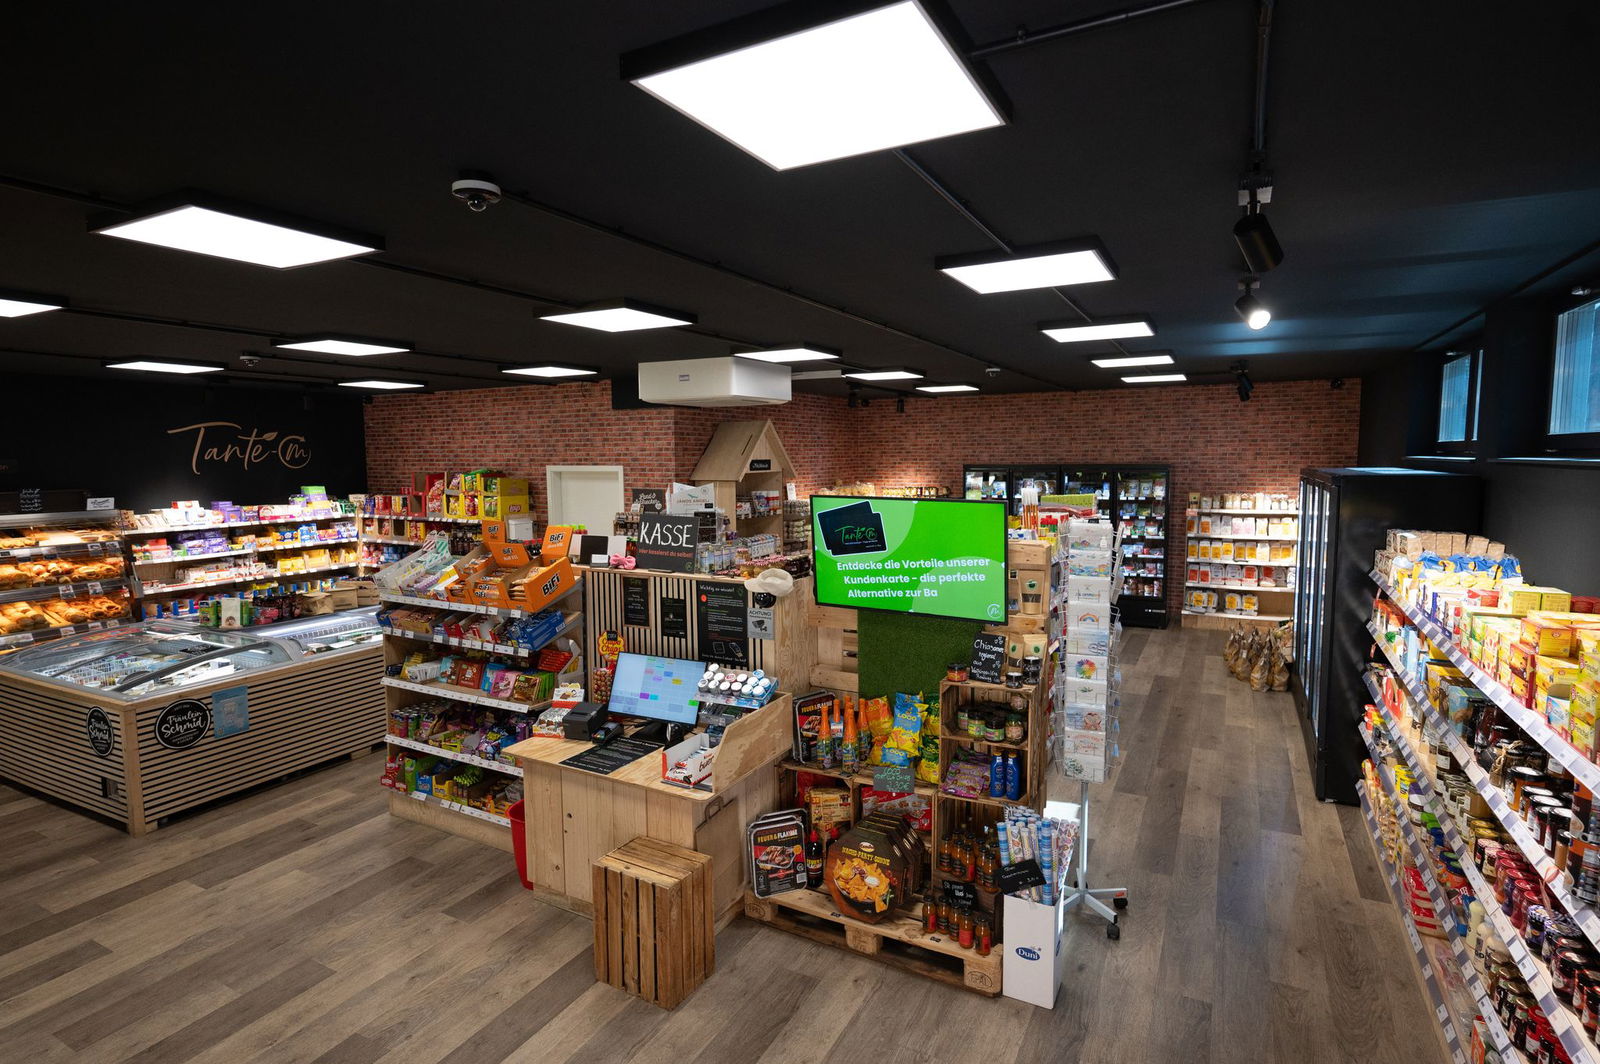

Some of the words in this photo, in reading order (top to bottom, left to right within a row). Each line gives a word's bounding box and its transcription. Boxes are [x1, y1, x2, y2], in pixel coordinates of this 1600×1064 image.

[549, 533, 564, 541] BiFi
[639, 521, 695, 548] KASSE
[837, 561, 882, 572] Entdecke
[885, 560, 901, 570] die
[902, 558, 944, 569] Vorteile
[946, 558, 990, 568] unserer
[542, 573, 561, 597] BiFi
[844, 574, 910, 585] Kundenkarte
[920, 573, 937, 582] die
[939, 572, 986, 585] perfekte
[848, 589, 904, 598] Alternative
[924, 589, 938, 597] Ba
[161, 716, 207, 739] Schmid
[1017, 949, 1039, 960] Duni
